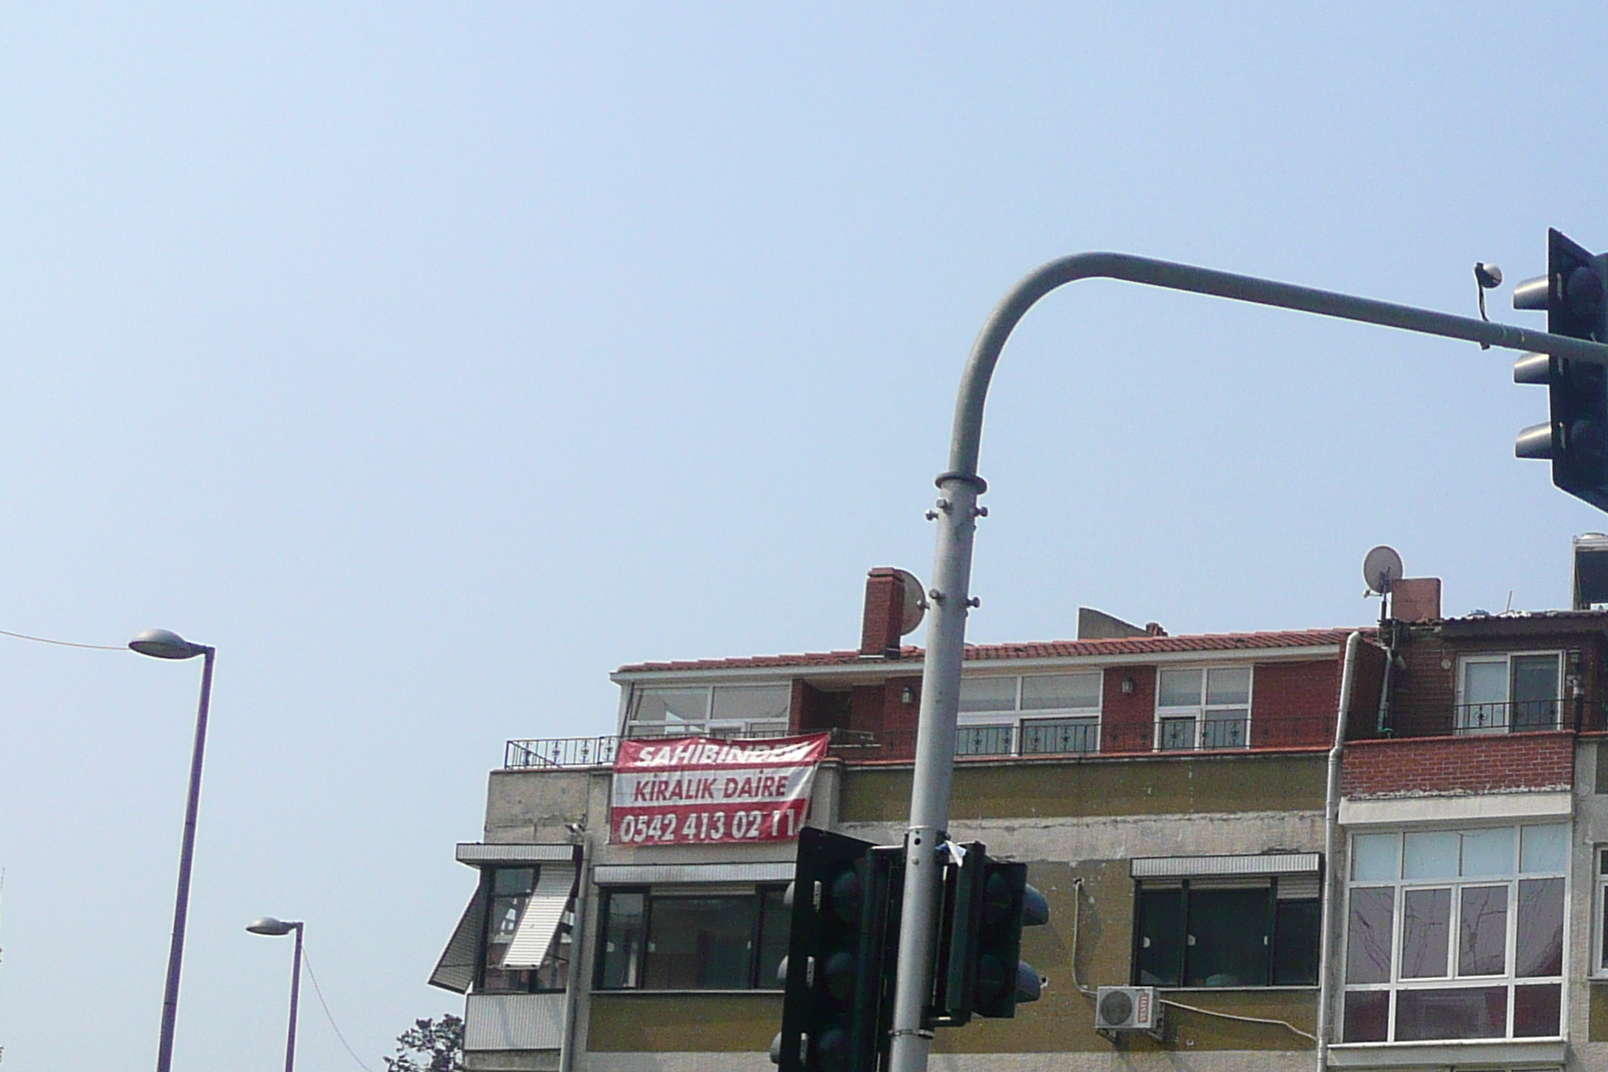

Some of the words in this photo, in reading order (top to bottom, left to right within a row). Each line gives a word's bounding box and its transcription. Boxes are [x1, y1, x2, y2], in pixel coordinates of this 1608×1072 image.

[634, 772, 717, 802] KİRALIK
[723, 769, 788, 799] DAİRE
[620, 813, 678, 843] 0542
[682, 811, 726, 840] 413
[732, 809, 762, 839] 02
[771, 808, 795, 837] 11
